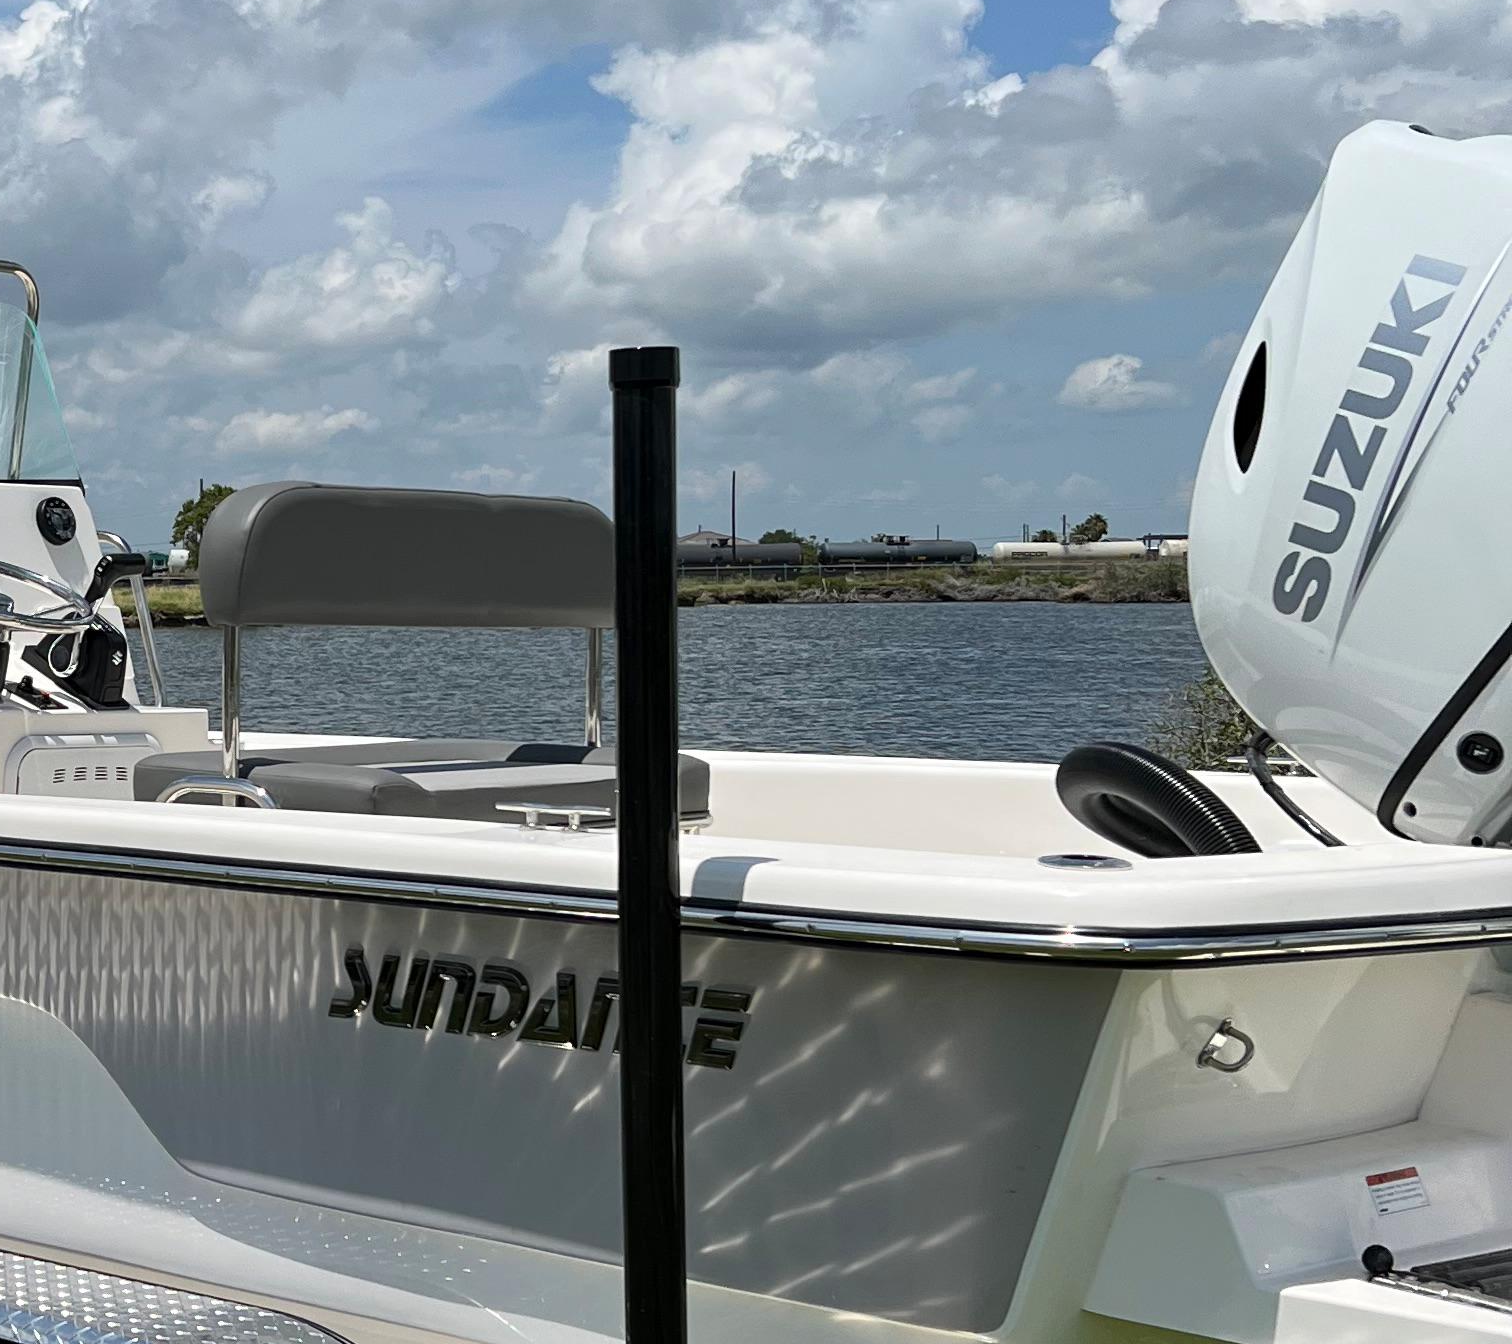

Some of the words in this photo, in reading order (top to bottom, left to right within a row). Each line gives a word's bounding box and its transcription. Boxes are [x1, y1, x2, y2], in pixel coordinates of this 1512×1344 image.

[1273, 254, 1468, 623] SUZUKI
[1446, 337, 1490, 415] FOUR
[328, 945, 755, 1070] SUNDANE
